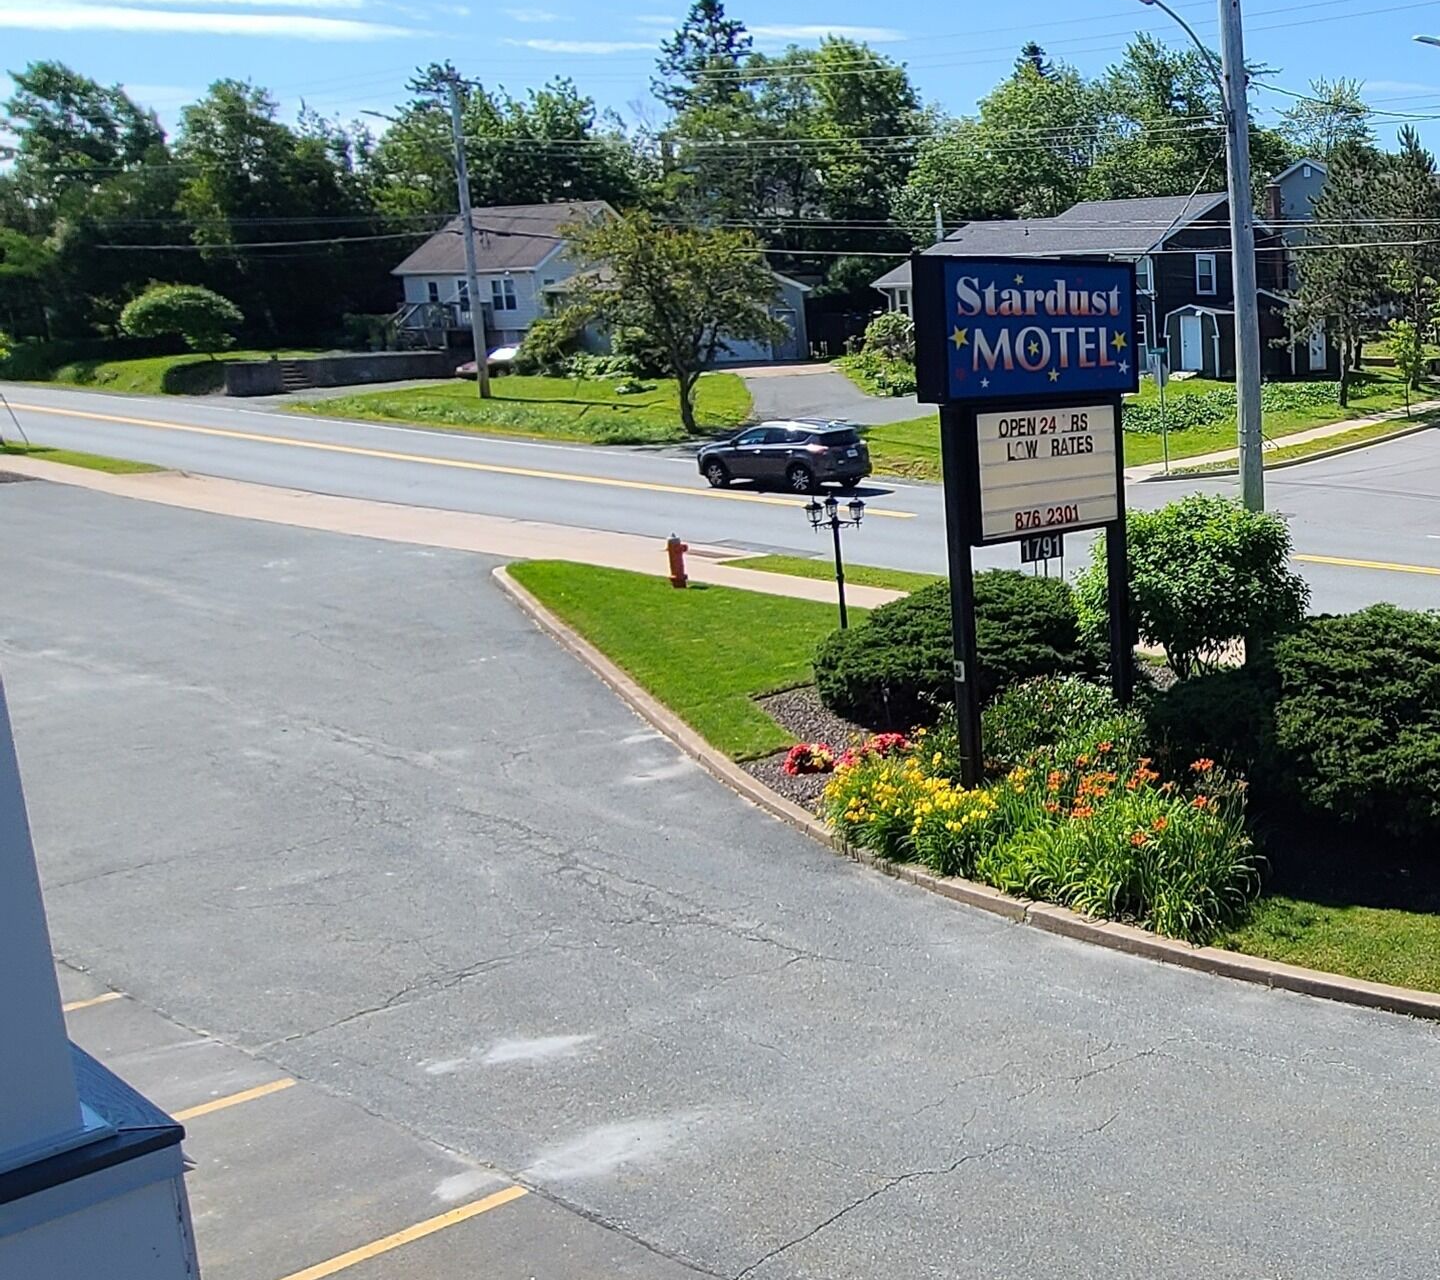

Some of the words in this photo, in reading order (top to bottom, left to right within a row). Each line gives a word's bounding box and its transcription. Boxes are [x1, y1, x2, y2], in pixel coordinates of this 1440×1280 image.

[956, 276, 1121, 316] Stardust
[973, 326, 1116, 371] MOTEL
[998, 417, 1036, 439] OPEN
[1040, 416, 1056, 435] 24
[1051, 435, 1093, 457] RATES
[1015, 510, 1041, 531] 876
[1047, 504, 1079, 526] 2301
[1023, 534, 1060, 560] 1791
